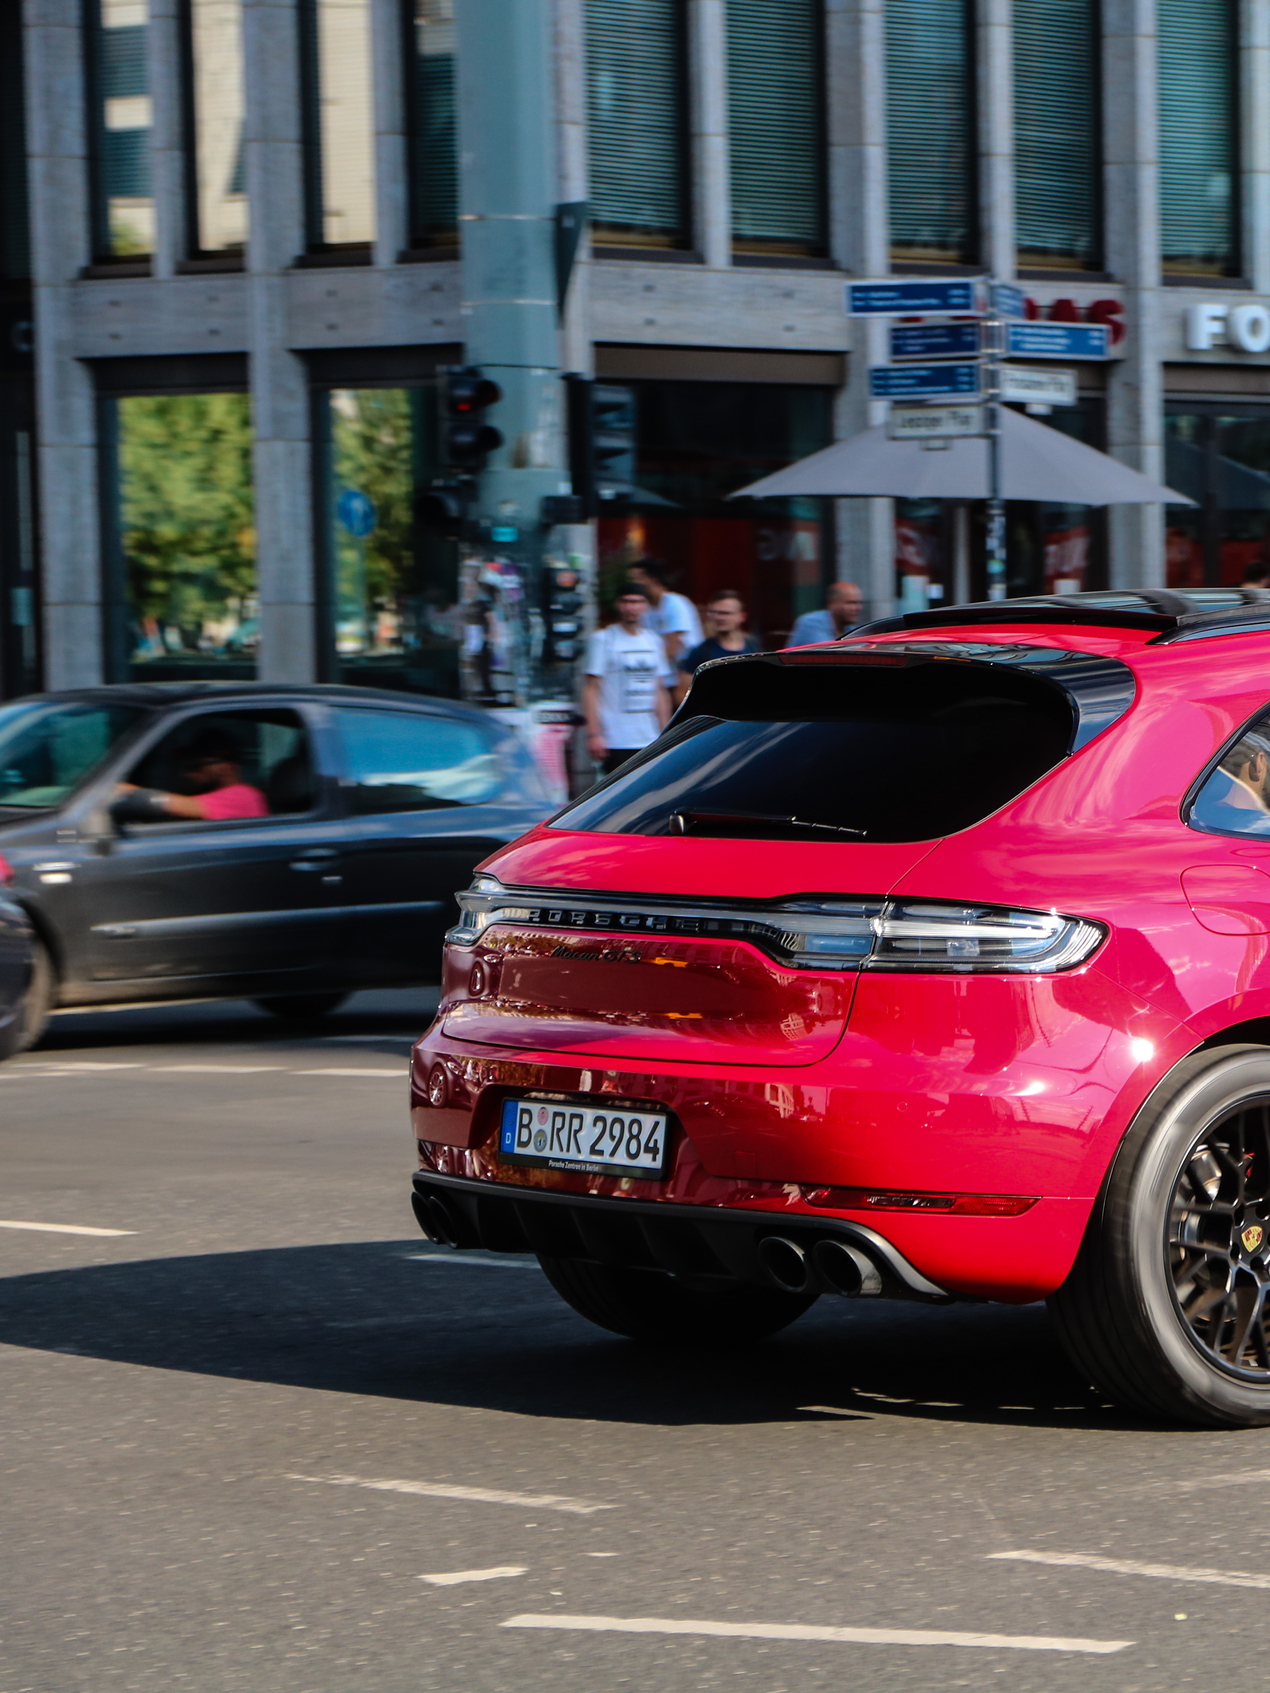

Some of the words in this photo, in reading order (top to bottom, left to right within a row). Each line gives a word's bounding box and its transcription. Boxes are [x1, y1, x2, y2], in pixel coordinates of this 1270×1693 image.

[528, 909, 700, 933] PORSCHE
[550, 945, 600, 961] Macan
[603, 949, 642, 964] GTS
[505, 1132, 512, 1144] D
[516, 1108, 533, 1148] B
[549, 1111, 584, 1154] RR
[589, 1115, 660, 1162] 2984
[548, 1159, 565, 1169] Porsche
[586, 1164, 599, 1172] Berlin
